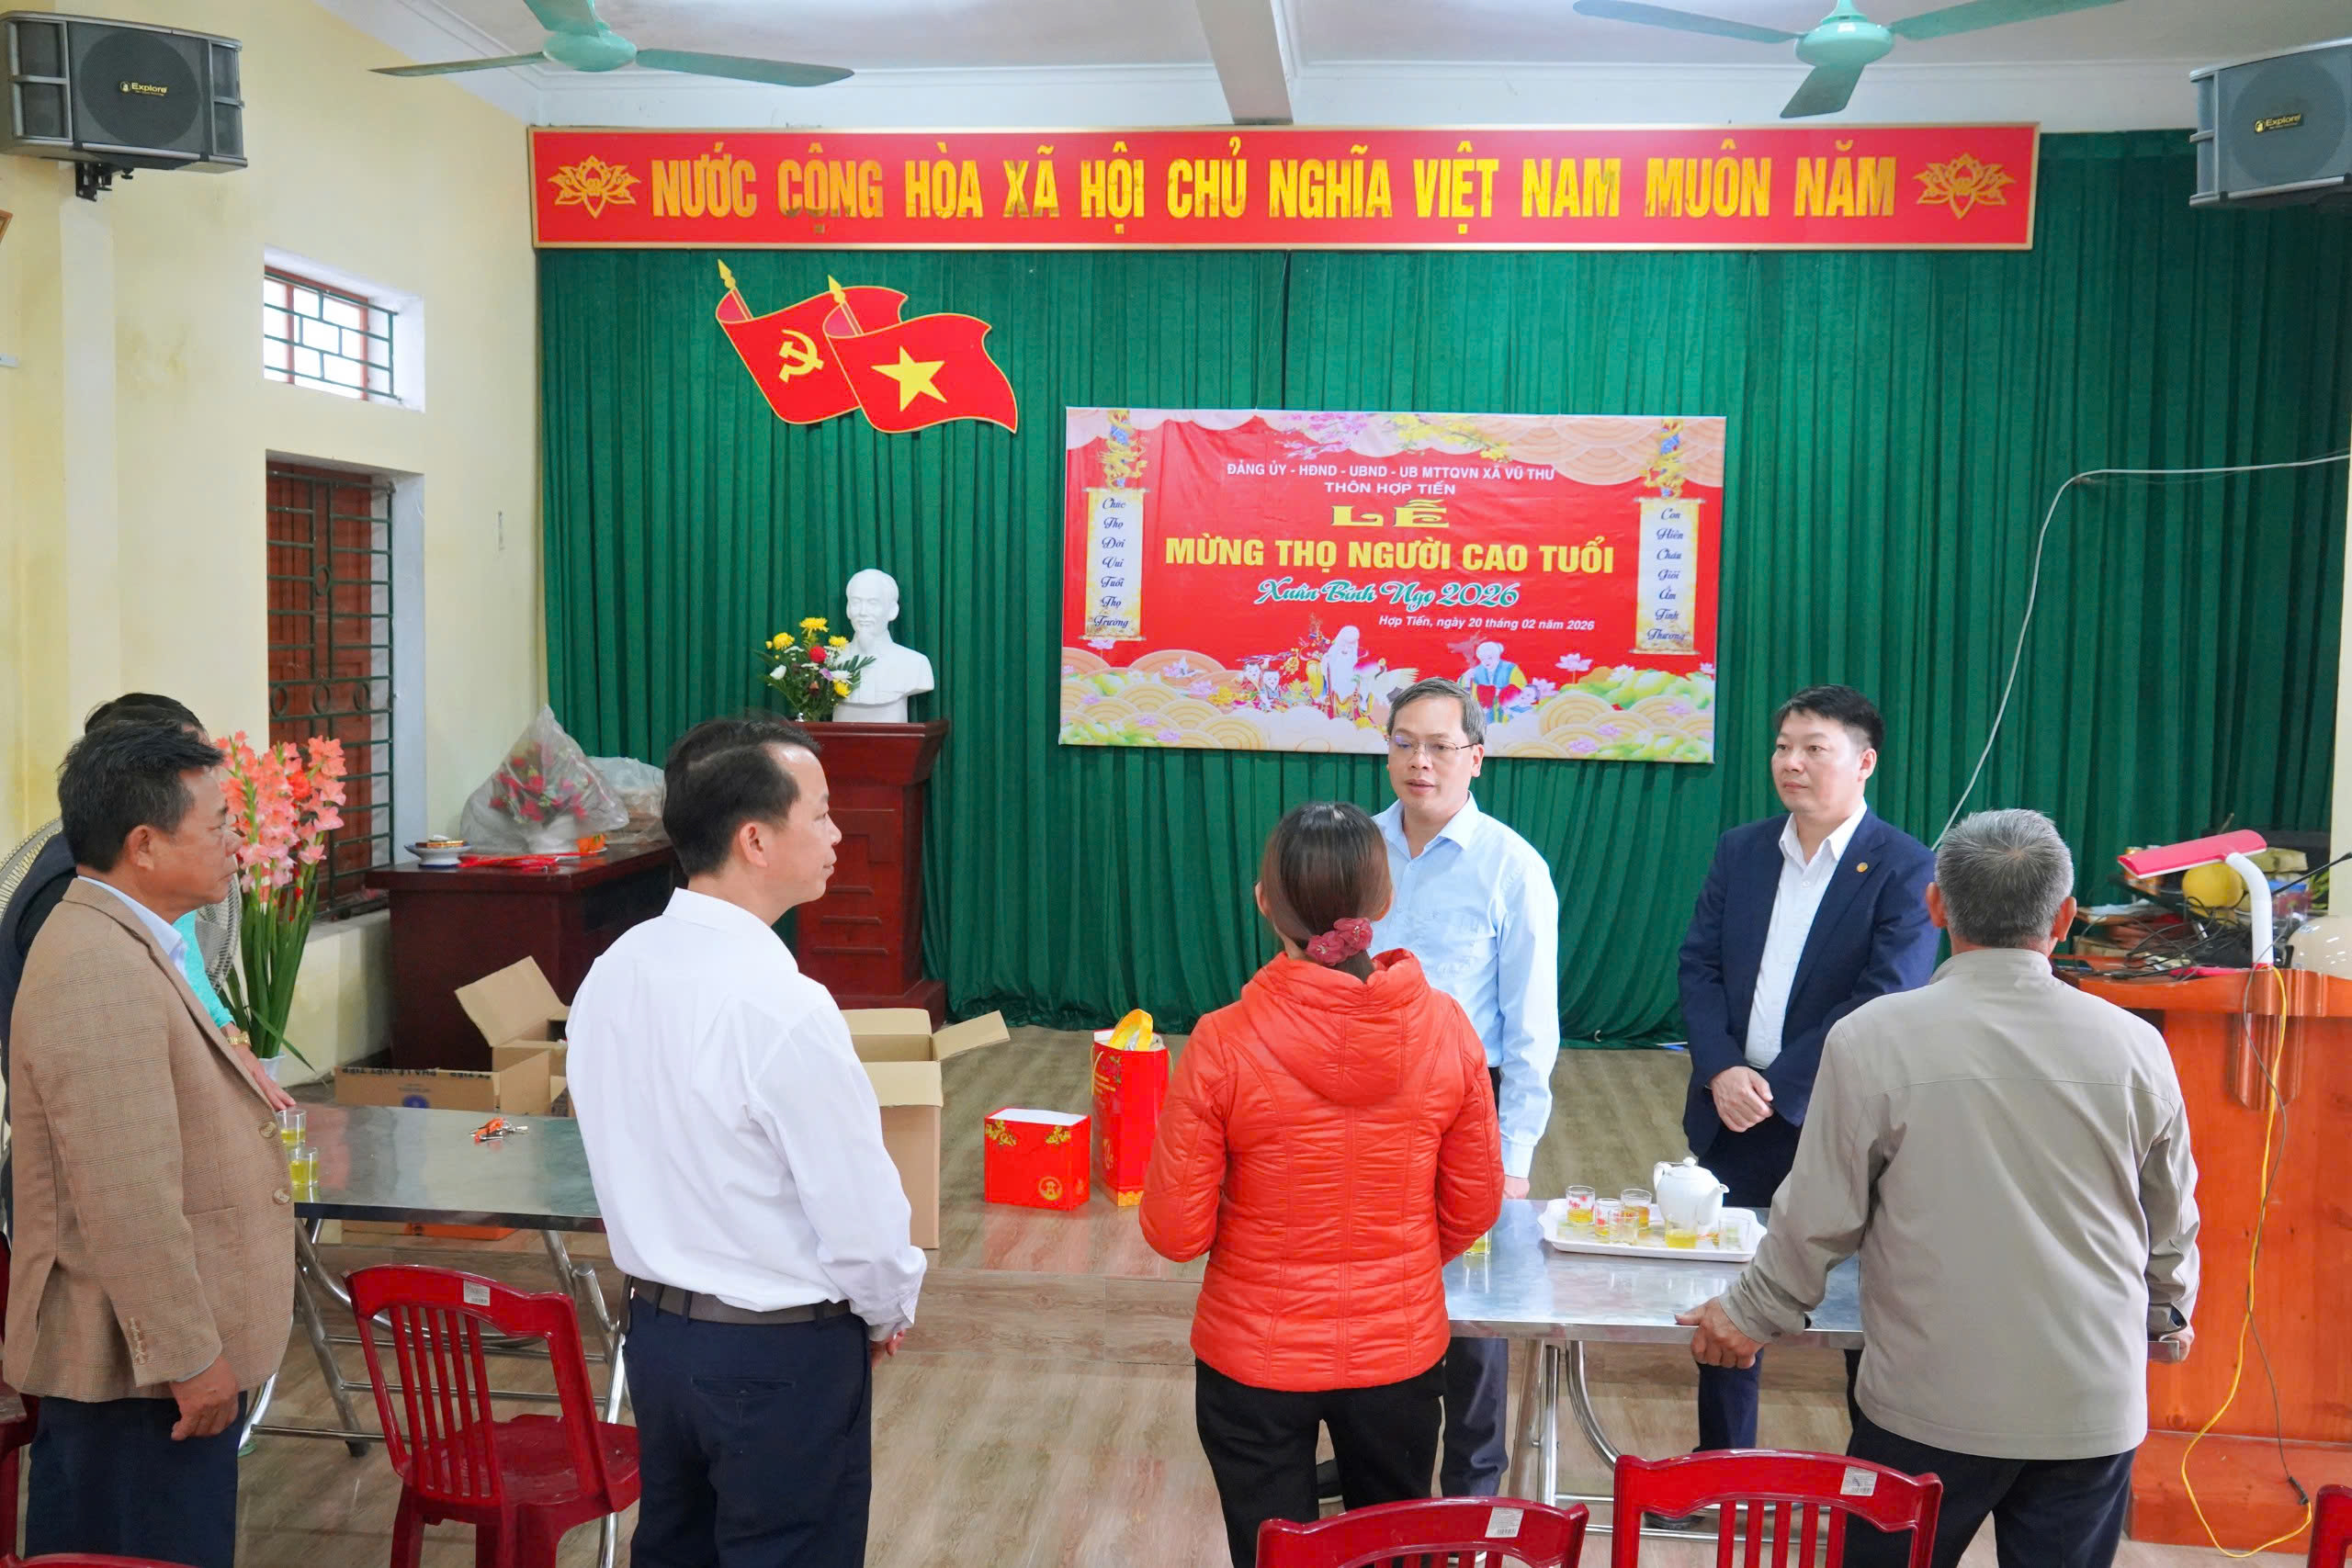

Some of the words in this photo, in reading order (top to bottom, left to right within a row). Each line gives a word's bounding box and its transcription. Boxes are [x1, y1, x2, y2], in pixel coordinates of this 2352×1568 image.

[650, 141, 757, 219] NƯỚC
[777, 141, 884, 234] CỘNG
[903, 141, 984, 220] HÒA
[1001, 143, 1060, 220] XÃ
[1080, 140, 1146, 234] HỘI
[1166, 135, 1248, 220] CHỦ
[1268, 143, 1395, 220] NGHĨA
[1411, 140, 1501, 236] VIỆT
[1520, 158, 1624, 220] NAM
[1643, 138, 1772, 220] MUÔN
[1792, 140, 1898, 219] NĂM
[1227, 458, 1265, 476] ĐẢNG
[1269, 460, 1287, 477] ỦY
[1298, 464, 1338, 477] HĐND
[1349, 465, 1388, 478] UBND
[1399, 466, 1419, 479] UB
[1421, 467, 1479, 479] MTTQVN
[1482, 465, 1502, 479] XÃ
[1504, 465, 1524, 480] VŨ
[1526, 467, 1558, 481] THƯ
[1323, 479, 1372, 493] THÔN
[1375, 480, 1412, 496] HỢP
[1417, 479, 1456, 495] TIẾN
[1330, 498, 1450, 528] LỄ
[1165, 532, 1265, 567] MỪNG
[1274, 539, 1338, 573] THỌ
[1347, 536, 1451, 570] NGƯỜI
[1462, 542, 1529, 572] CAO
[1538, 535, 1615, 574] TUỔI
[1254, 577, 1319, 604] Xuân
[1320, 580, 1377, 604] Bính
[1379, 581, 1436, 613] Ngọ
[1436, 581, 1521, 607] 2026
[1378, 615, 1403, 628] Hợp
[1406, 615, 1433, 627] Tiến,
[1436, 616, 1465, 630] ngày
[1467, 617, 1483, 627] 20
[1485, 617, 1519, 631] tháng
[1521, 618, 1536, 629] 02
[1538, 619, 1564, 630] năm
[1566, 619, 1596, 631] 2026
